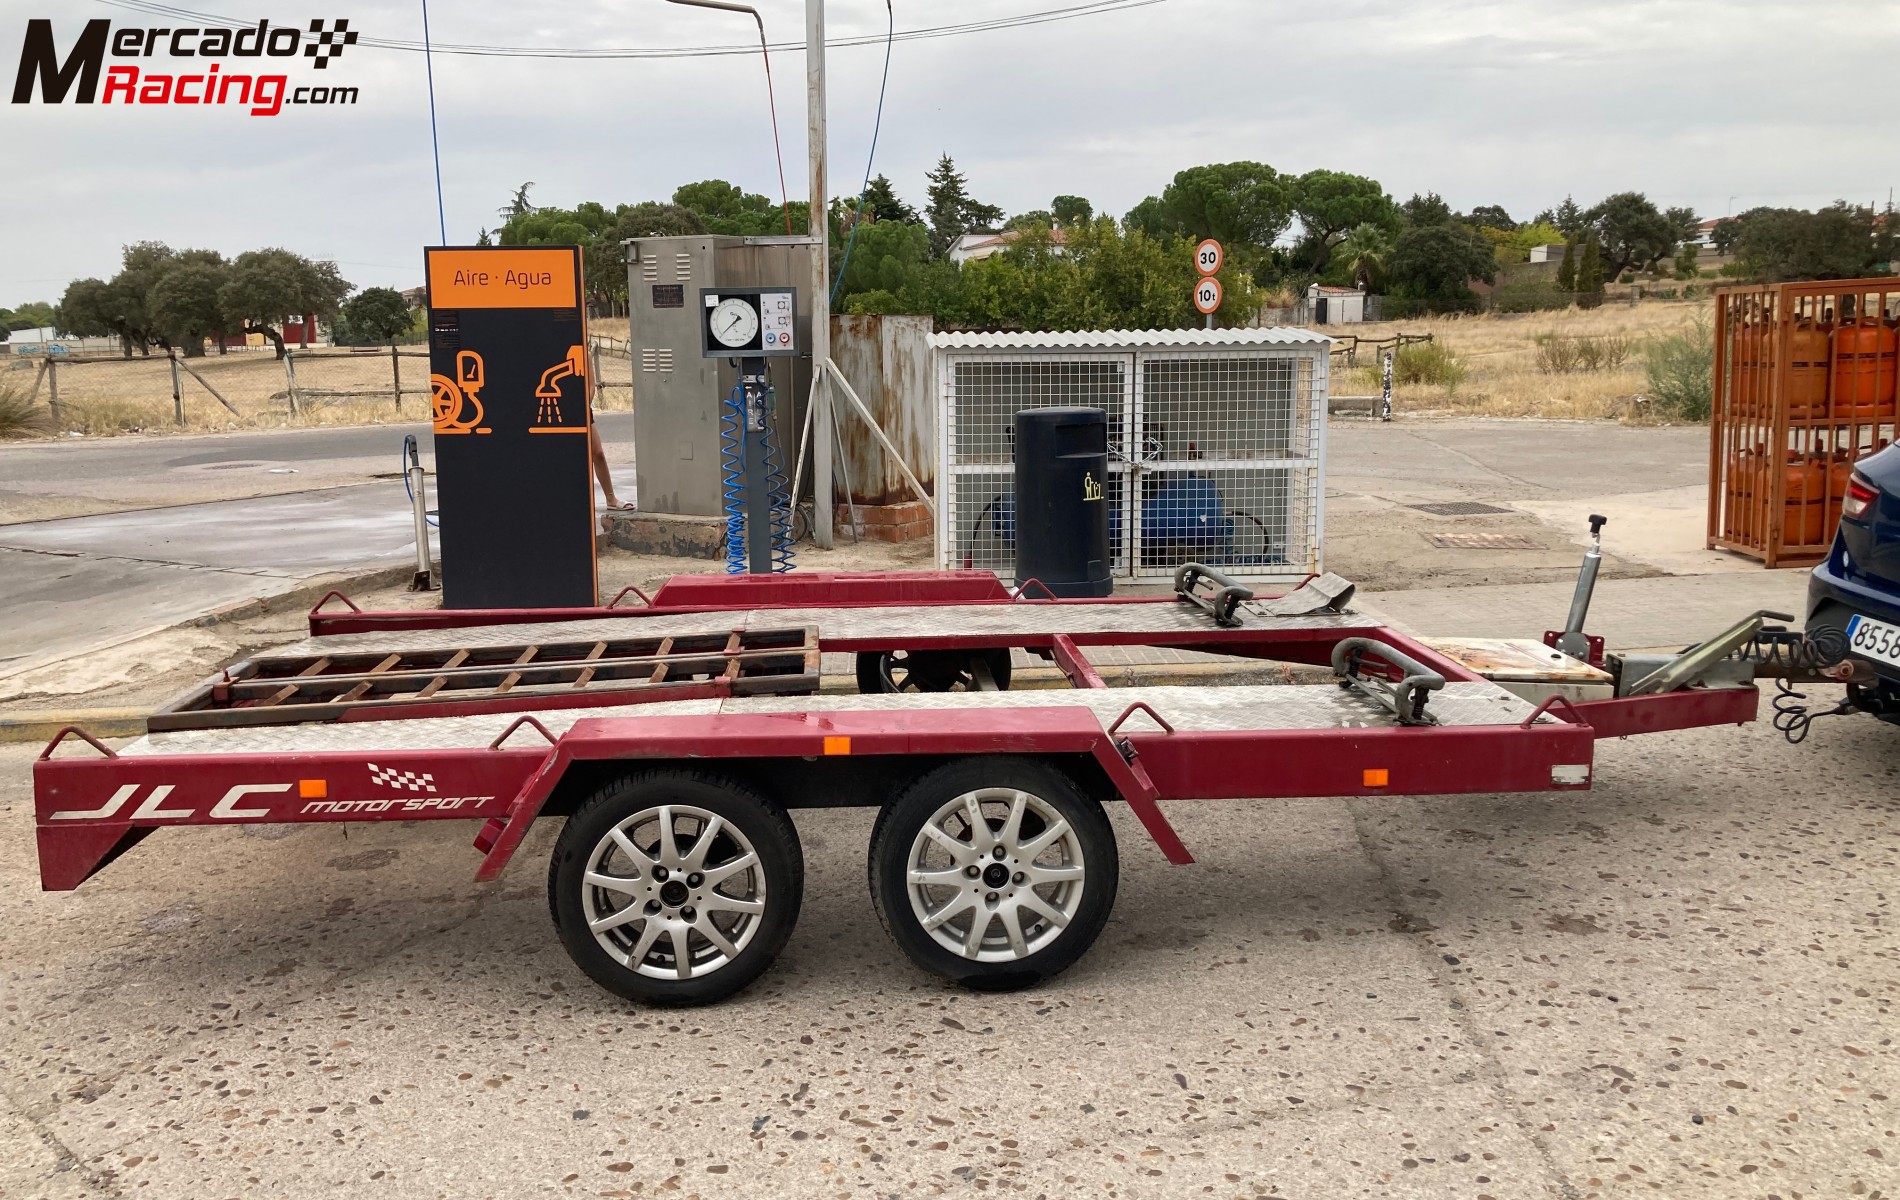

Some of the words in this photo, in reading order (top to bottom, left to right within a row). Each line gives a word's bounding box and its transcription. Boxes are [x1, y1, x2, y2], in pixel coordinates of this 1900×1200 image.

[1200, 252, 1216, 264] 30
[453, 269, 489, 286] Aire
[505, 269, 552, 290] Agua
[746, 391, 754, 425] AIRE
